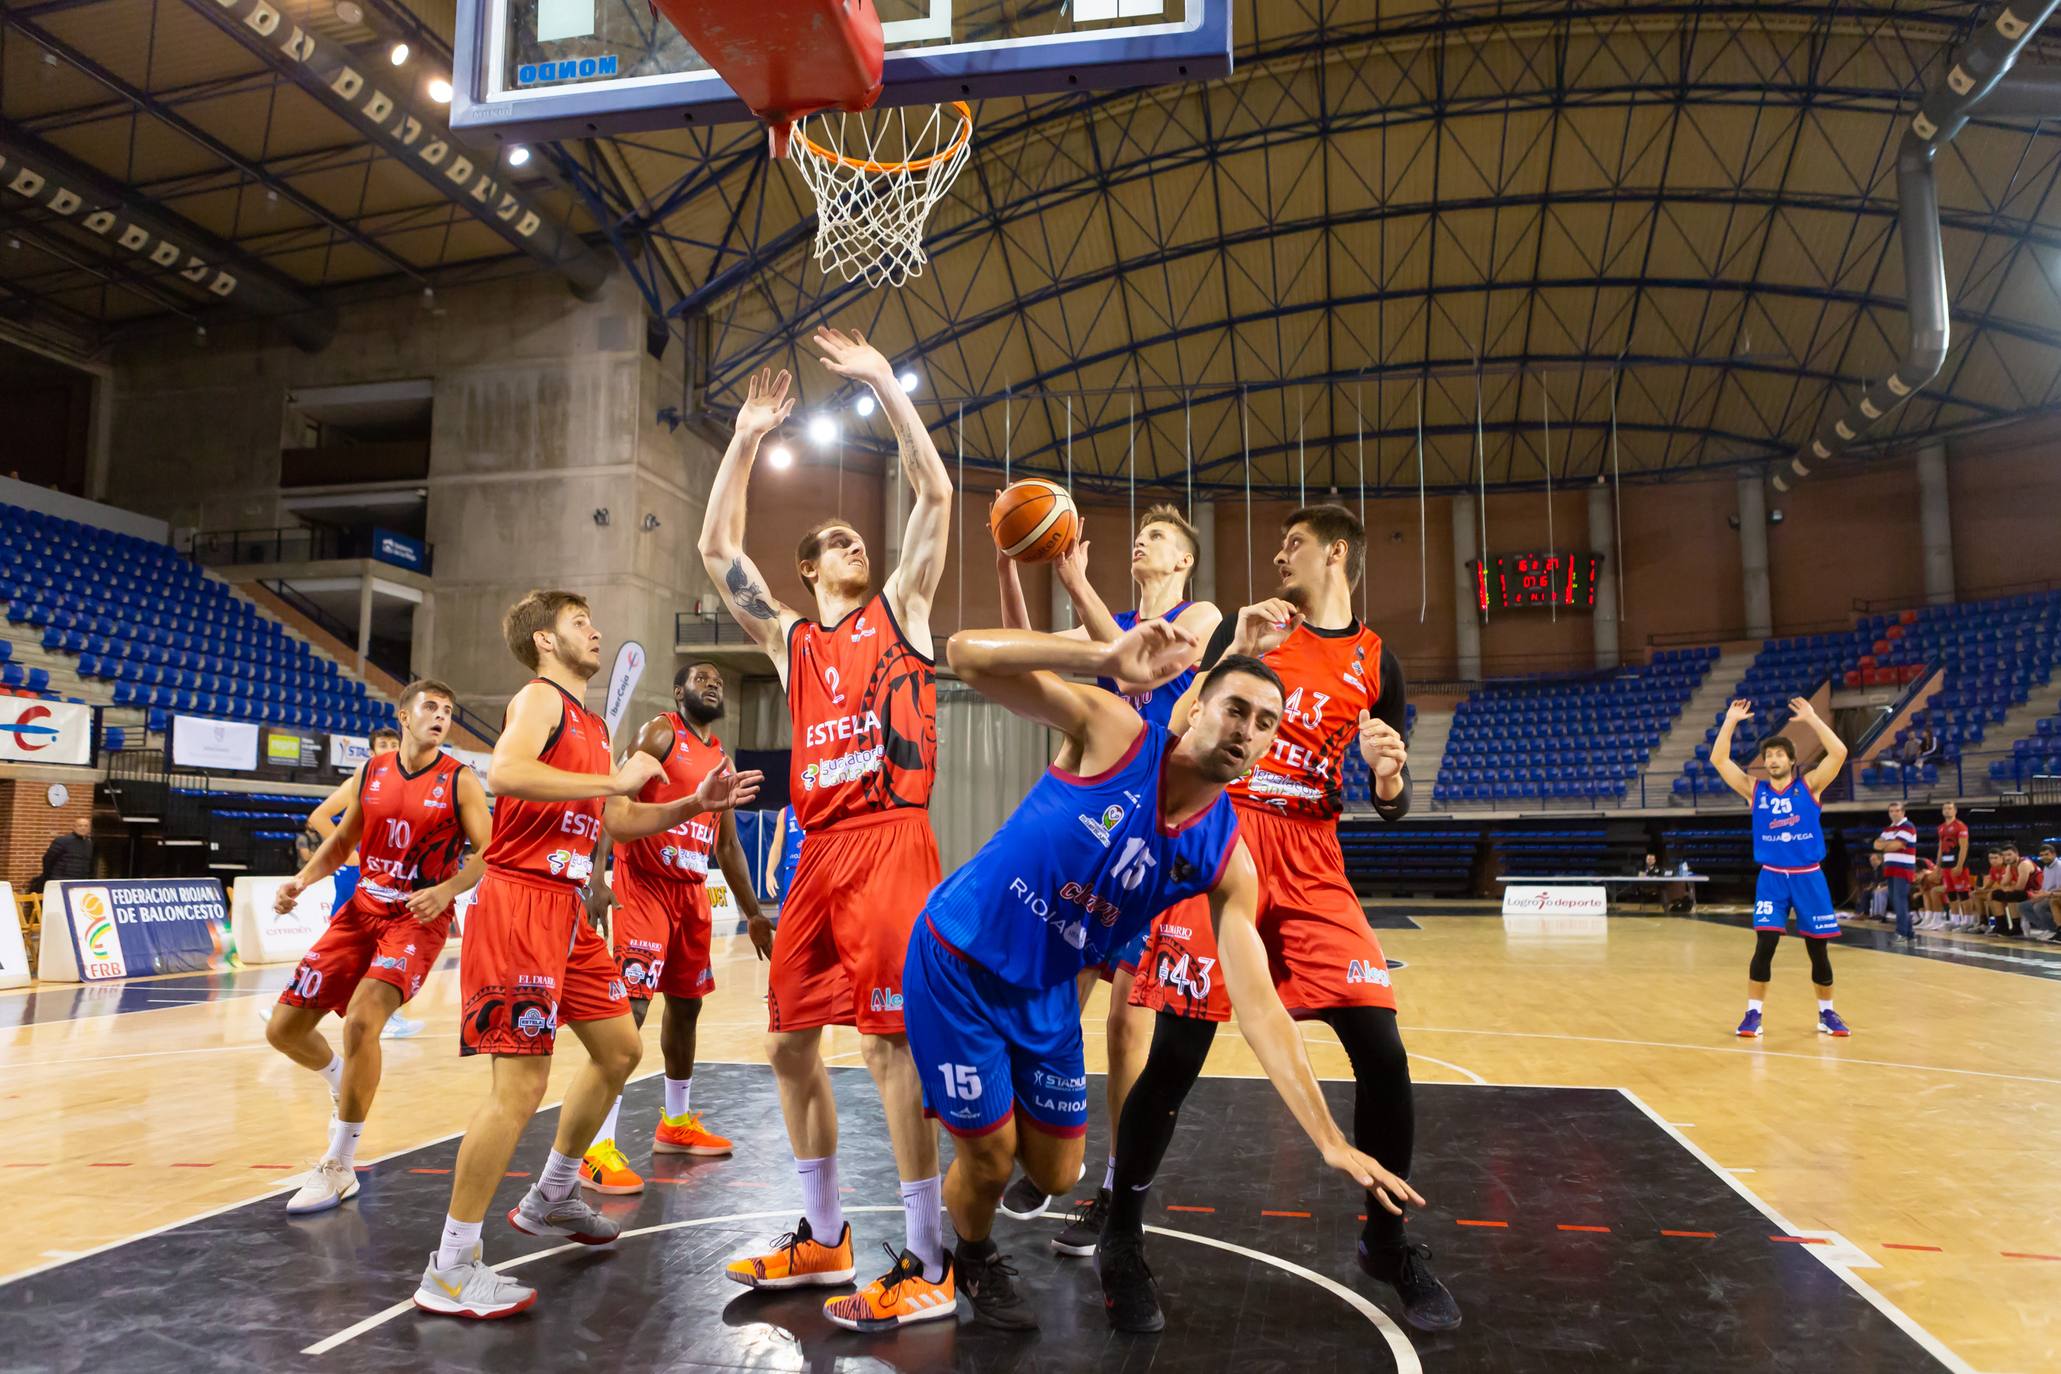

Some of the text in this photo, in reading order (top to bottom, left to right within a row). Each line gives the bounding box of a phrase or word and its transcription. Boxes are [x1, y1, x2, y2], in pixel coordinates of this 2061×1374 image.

[1284, 686, 1331, 729] 43
[806, 709, 881, 748] ESTELA
[1274, 737, 1329, 780] TELA
[1770, 797, 1792, 814] 25
[386, 818, 411, 849] 10
[1110, 837, 1157, 890] 15
[111, 888, 178, 905] FEDERACION
[1756, 901, 1773, 915] 25
[118, 904, 225, 923] DE BALONCESTO
[90, 962, 121, 977] FRB
[293, 966, 323, 999] 10
[1170, 953, 1216, 999] 43
[937, 1062, 982, 1100] 15
[1035, 1095, 1055, 1111] LA
